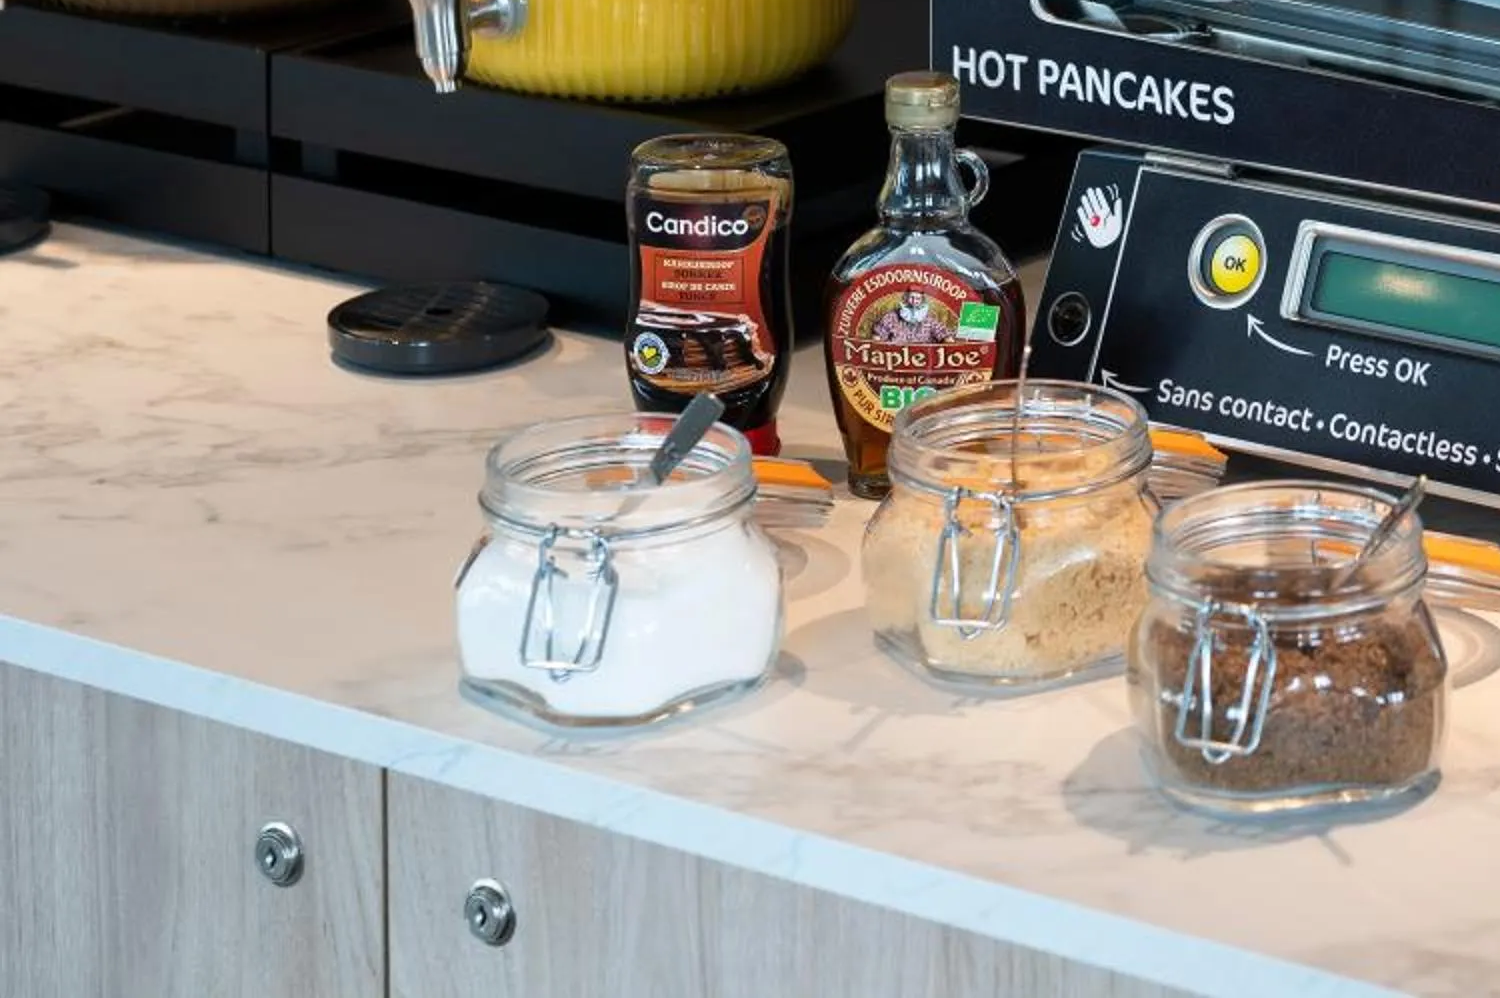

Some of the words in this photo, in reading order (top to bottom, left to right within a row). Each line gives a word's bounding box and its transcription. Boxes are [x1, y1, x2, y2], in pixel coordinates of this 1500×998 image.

[952, 44, 1028, 91] HOT
[1037, 58, 1235, 125] PANCAKES
[646, 211, 749, 236] Candico
[1223, 256, 1247, 272] OK
[843, 339, 927, 370] Maple
[1325, 344, 1388, 379] Press
[1394, 358, 1431, 387] OK
[853, 389, 875, 414] PUR
[1157, 378, 1213, 412] Sans
[1218, 395, 1313, 432] contact
[1329, 413, 1477, 466] Contactless
